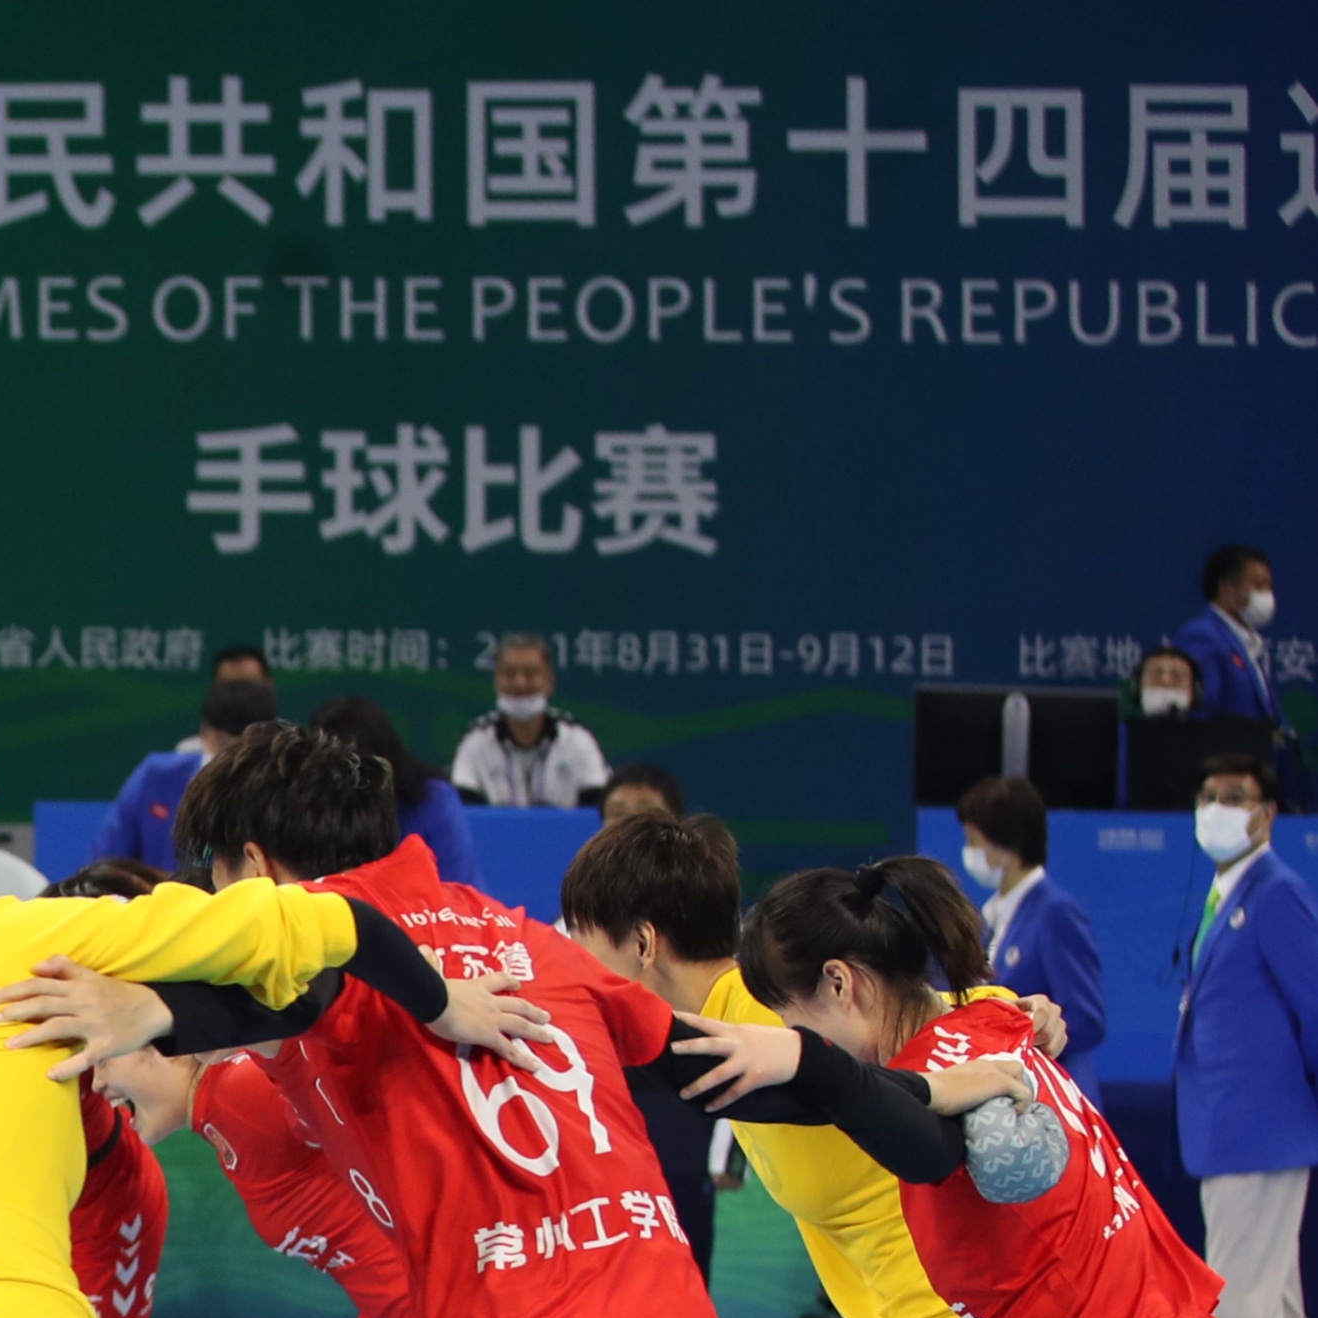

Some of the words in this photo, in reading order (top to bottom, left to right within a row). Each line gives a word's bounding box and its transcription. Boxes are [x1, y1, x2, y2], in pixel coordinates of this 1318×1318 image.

[152, 275, 262, 343] OF
[281, 275, 445, 342] THE
[470, 273, 872, 345] PEOPLE'S
[900, 277, 1318, 347] REPUBLIC
[186, 422, 720, 556] 手球比赛
[455, 1022, 612, 1177] 69
